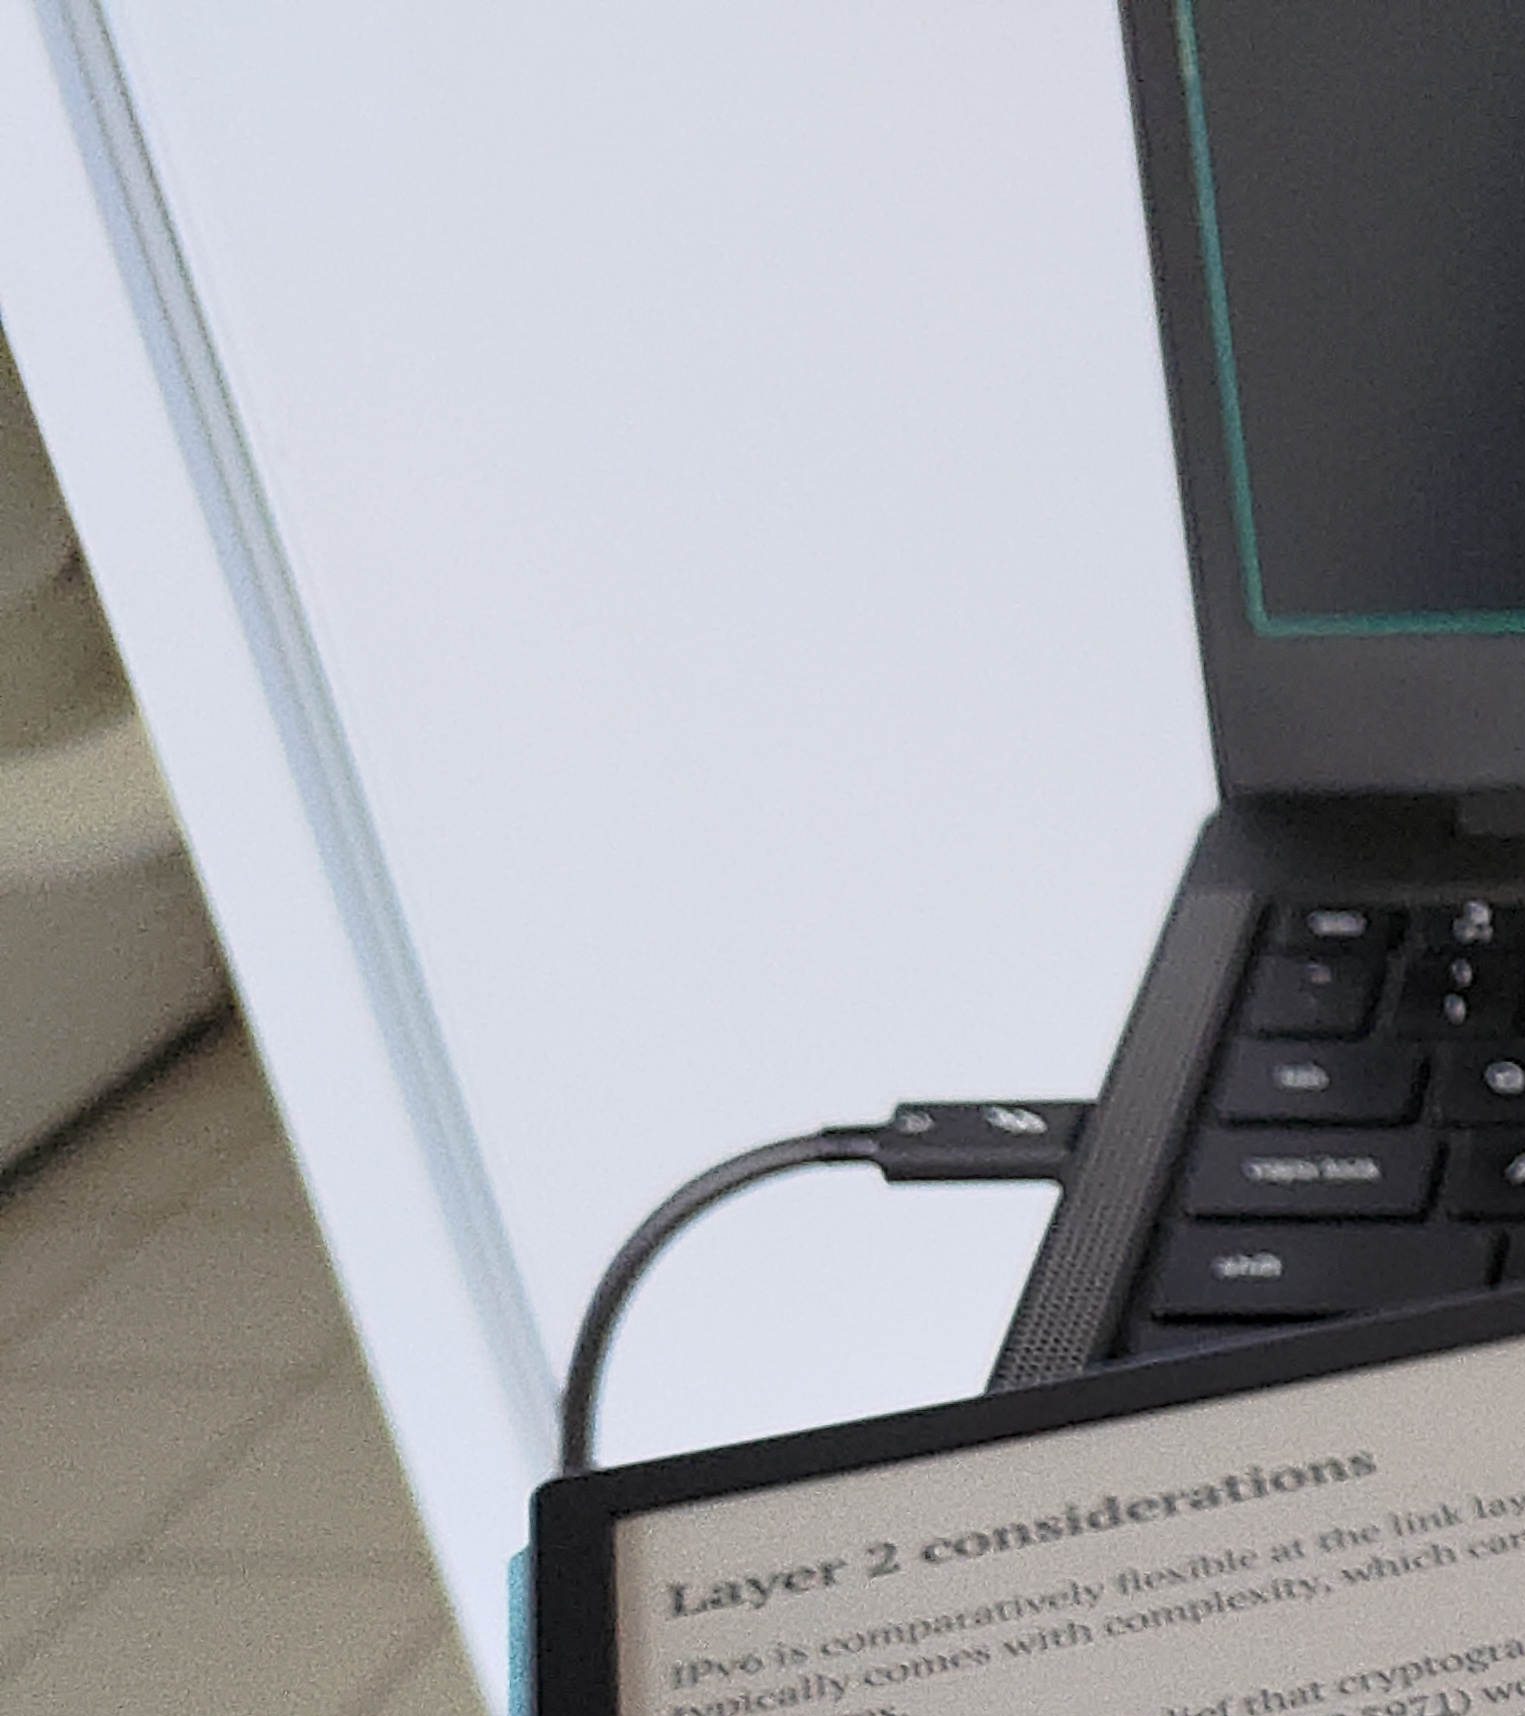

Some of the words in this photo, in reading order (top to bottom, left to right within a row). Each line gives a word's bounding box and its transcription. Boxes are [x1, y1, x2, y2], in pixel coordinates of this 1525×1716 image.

[666, 1558, 848, 1619] Layer
[864, 1541, 901, 1580] 2
[917, 1450, 1378, 1566] considerations
